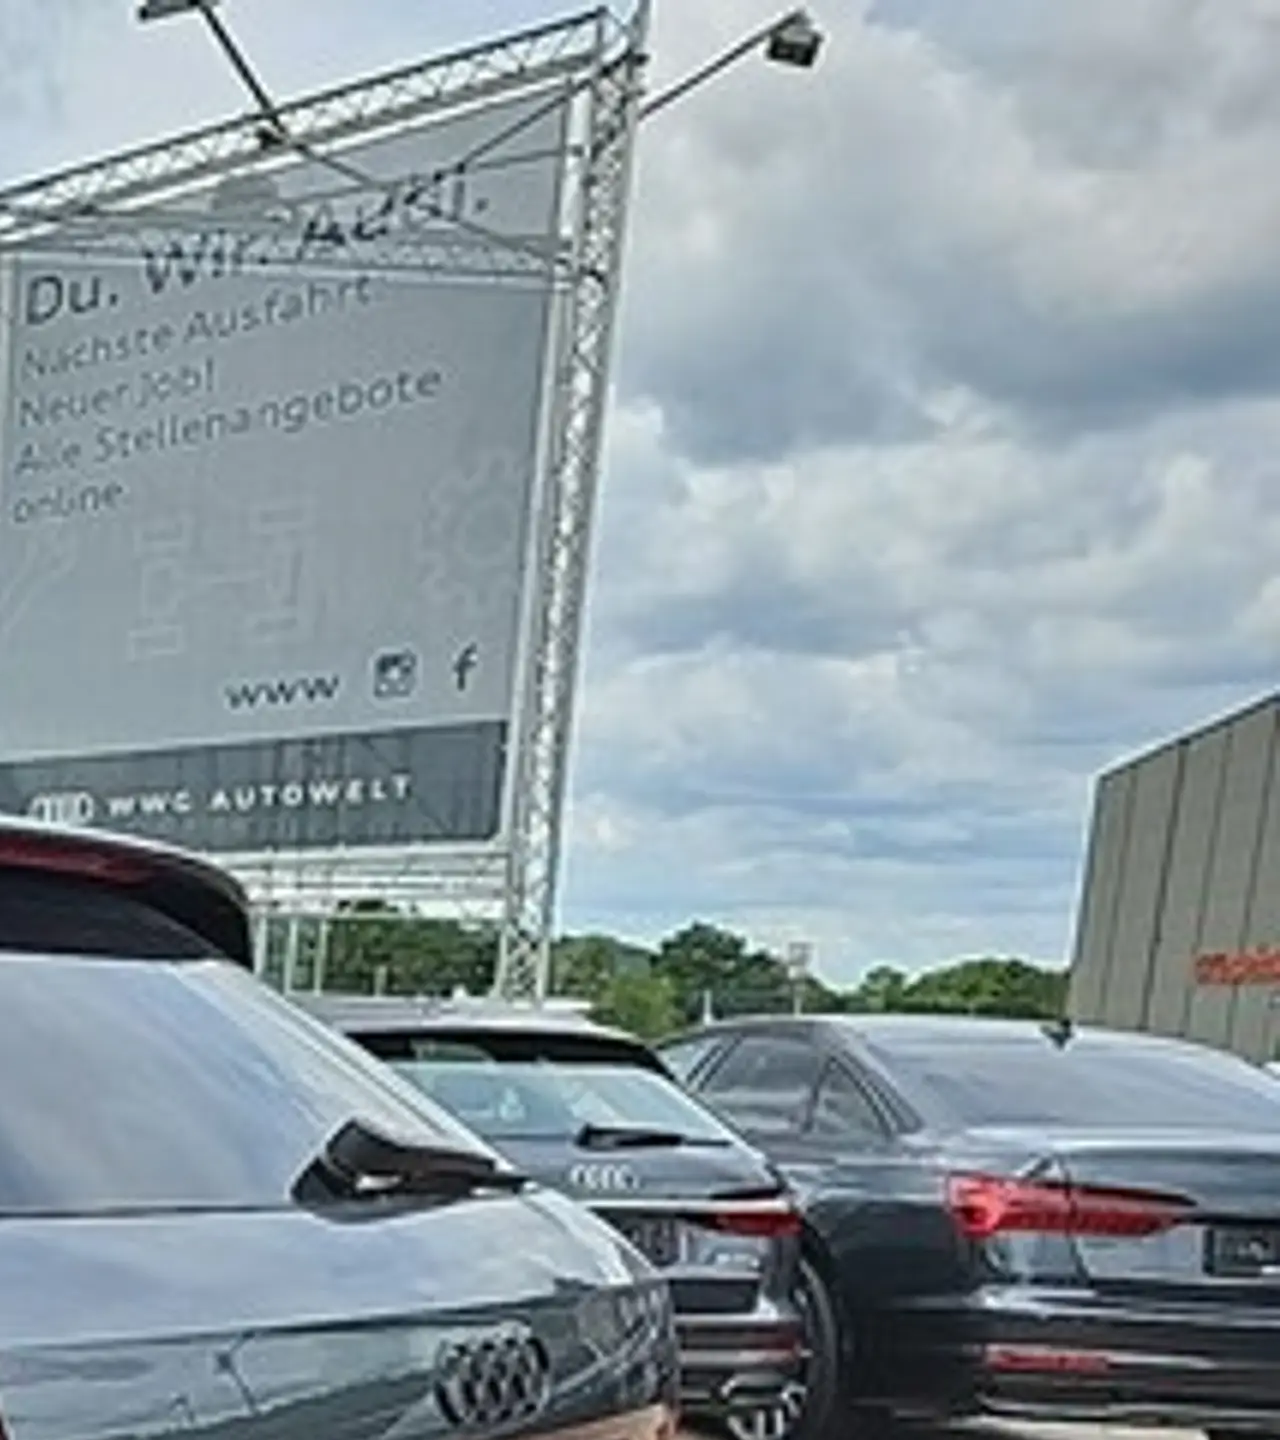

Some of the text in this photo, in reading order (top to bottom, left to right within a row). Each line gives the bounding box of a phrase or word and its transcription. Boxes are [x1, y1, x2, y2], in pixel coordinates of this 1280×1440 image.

[26, 274, 119, 326] Du.
[225, 674, 339, 710] www
[210, 774, 412, 811] AUTOWELT
